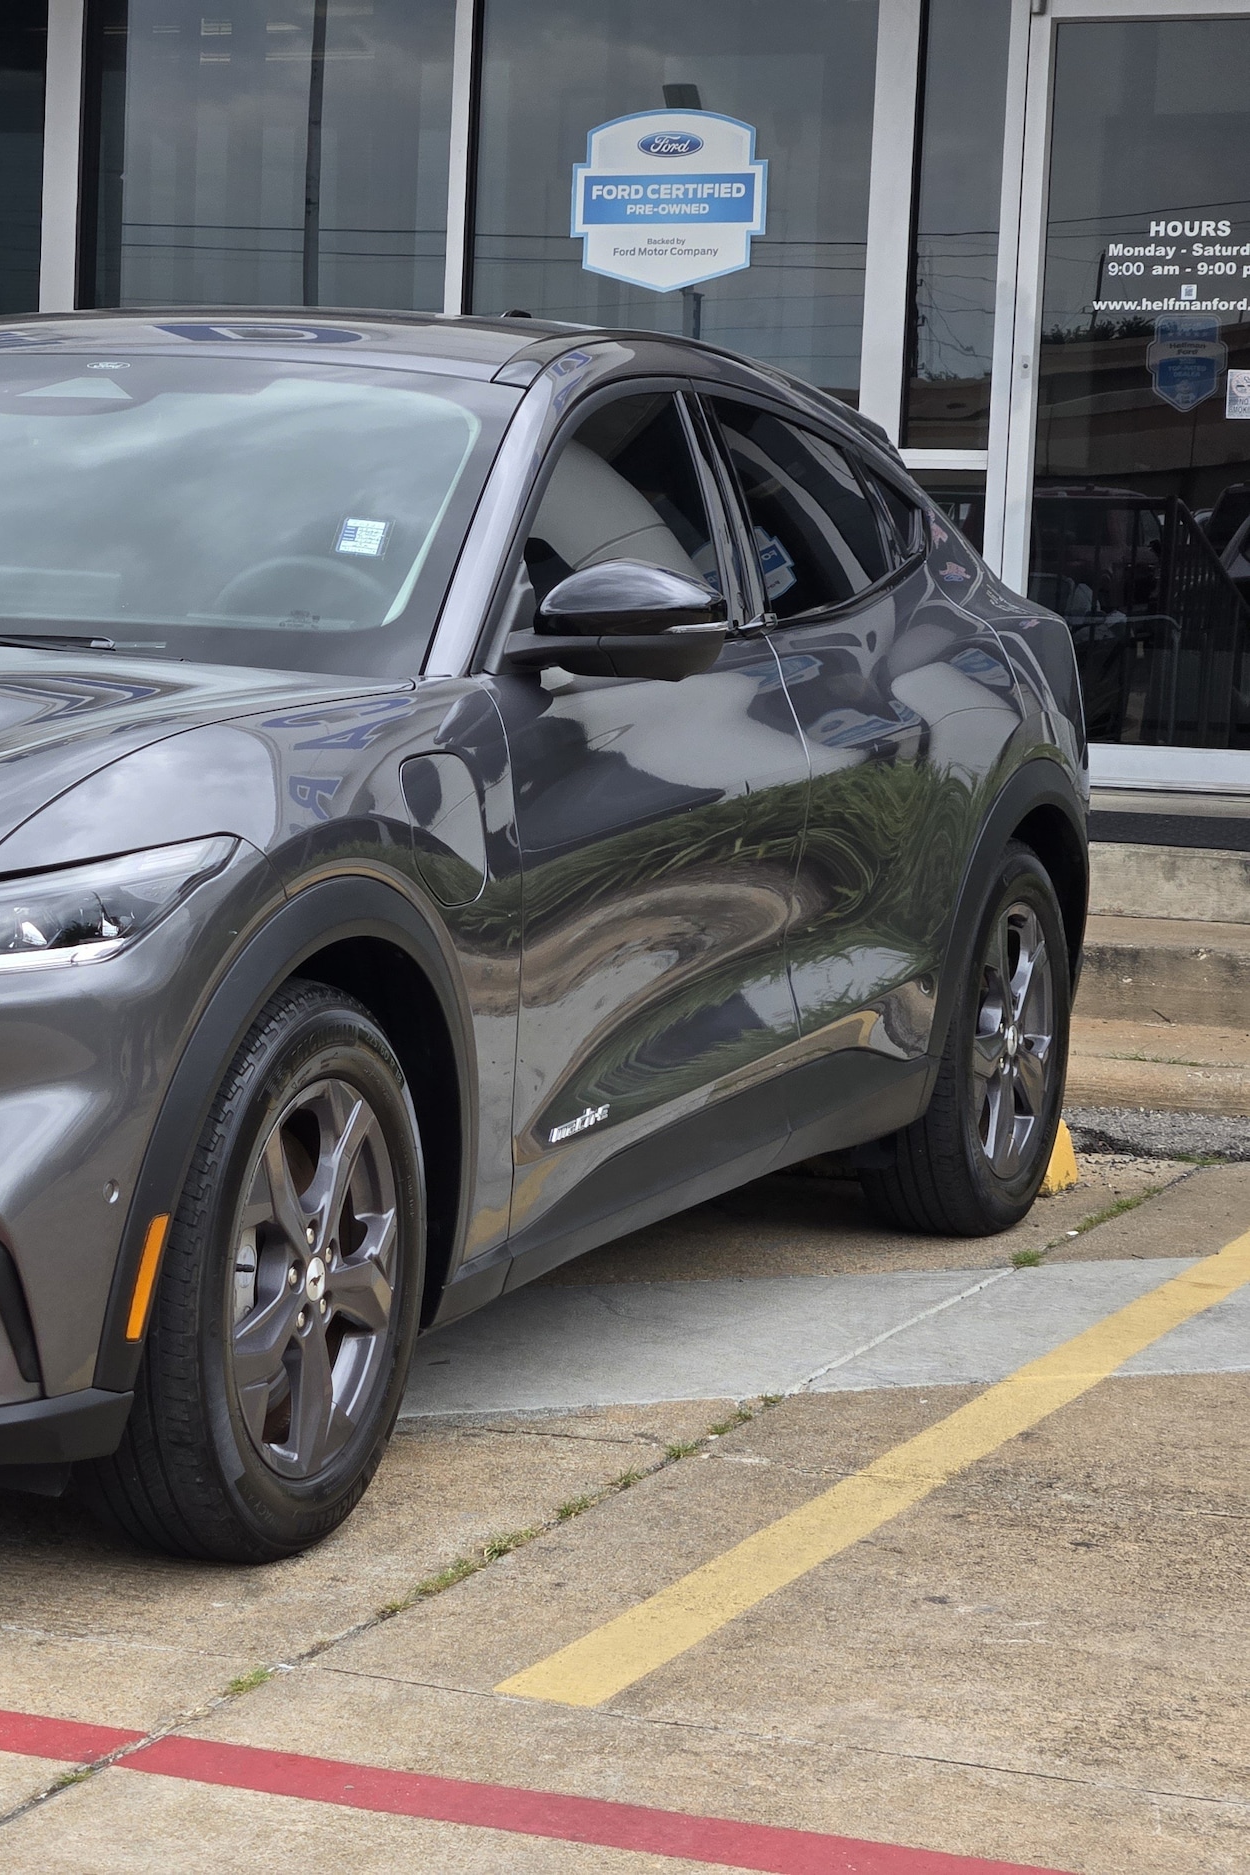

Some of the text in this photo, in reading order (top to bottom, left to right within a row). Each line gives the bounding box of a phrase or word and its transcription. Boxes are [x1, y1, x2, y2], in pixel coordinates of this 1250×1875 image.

[592, 183, 746, 200] FORD CERTIFIED
[626, 204, 710, 215] PRE-OWNED
[1150, 220, 1231, 237] HOURS
[647, 238, 686, 247] Backed by
[613, 247, 719, 258] Ford Motor Company
[1108, 243, 1176, 260] Monday
[1192, 243, 1250, 256] Saturd
[1108, 262, 1145, 276] 9:00
[1151, 264, 1180, 275] am
[1197, 262, 1237, 276] 9:00
